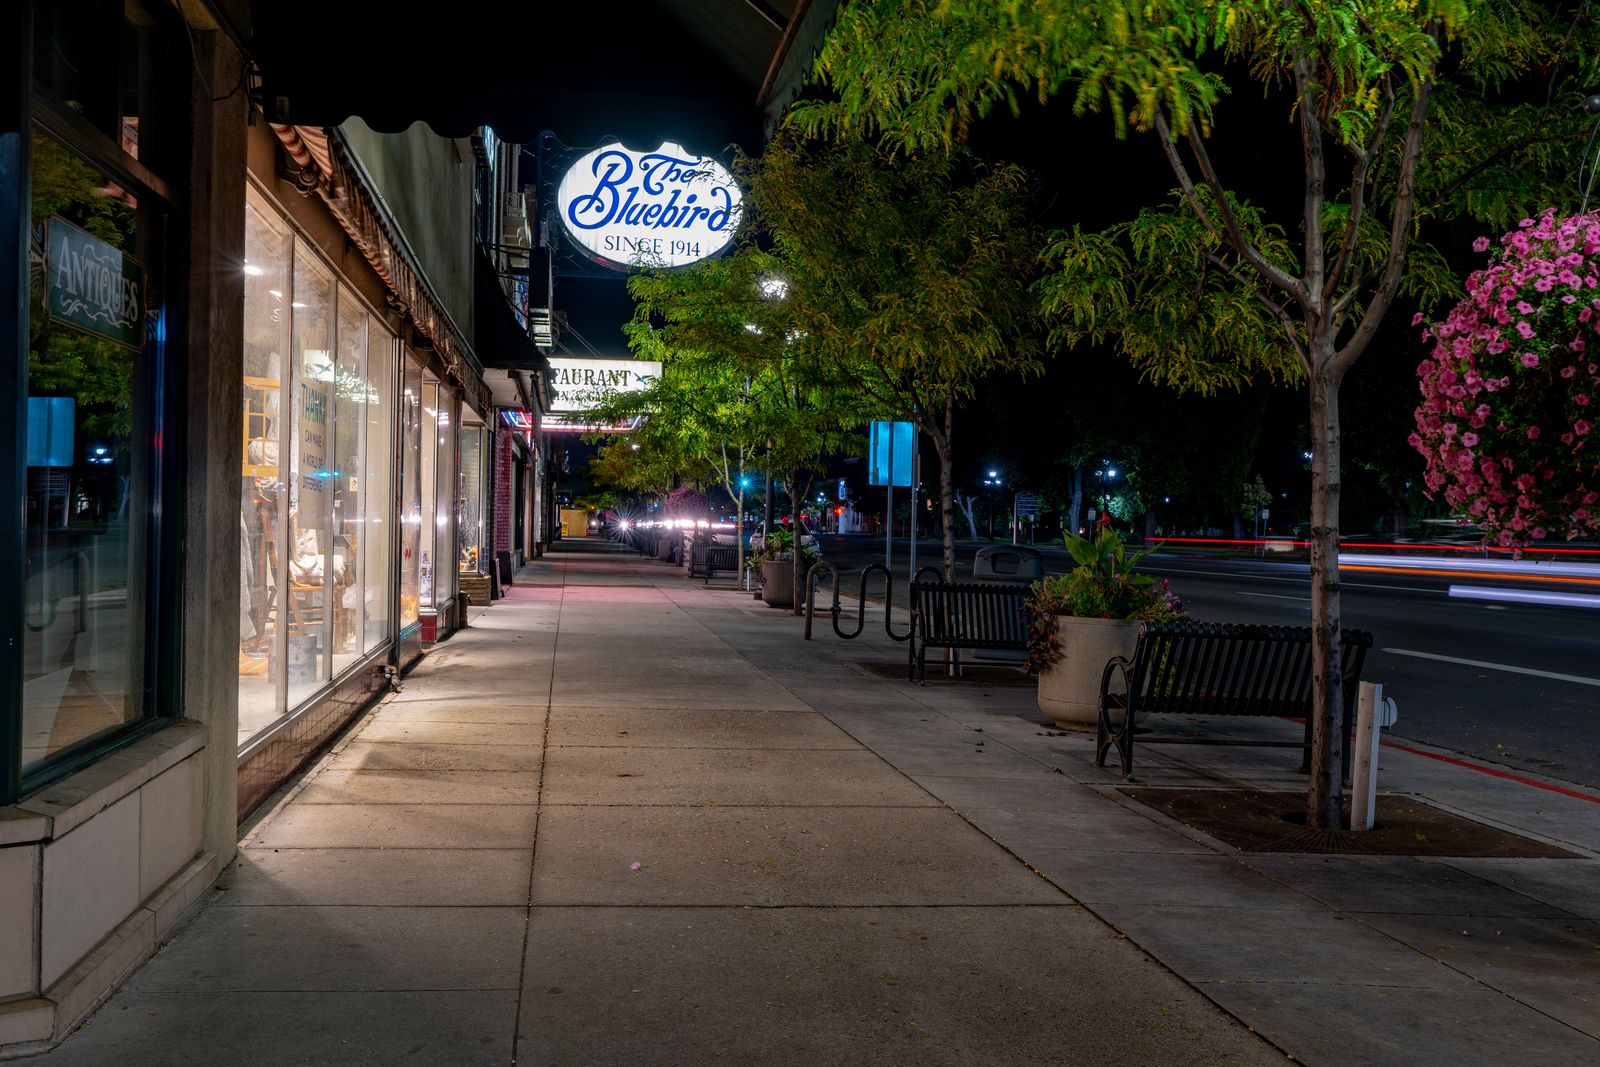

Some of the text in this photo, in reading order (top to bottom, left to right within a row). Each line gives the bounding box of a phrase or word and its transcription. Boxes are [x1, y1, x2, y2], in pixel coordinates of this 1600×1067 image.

[568, 150, 733, 232] Bluebird
[639, 154, 703, 196] The
[604, 235, 701, 257] SINCE 1914
